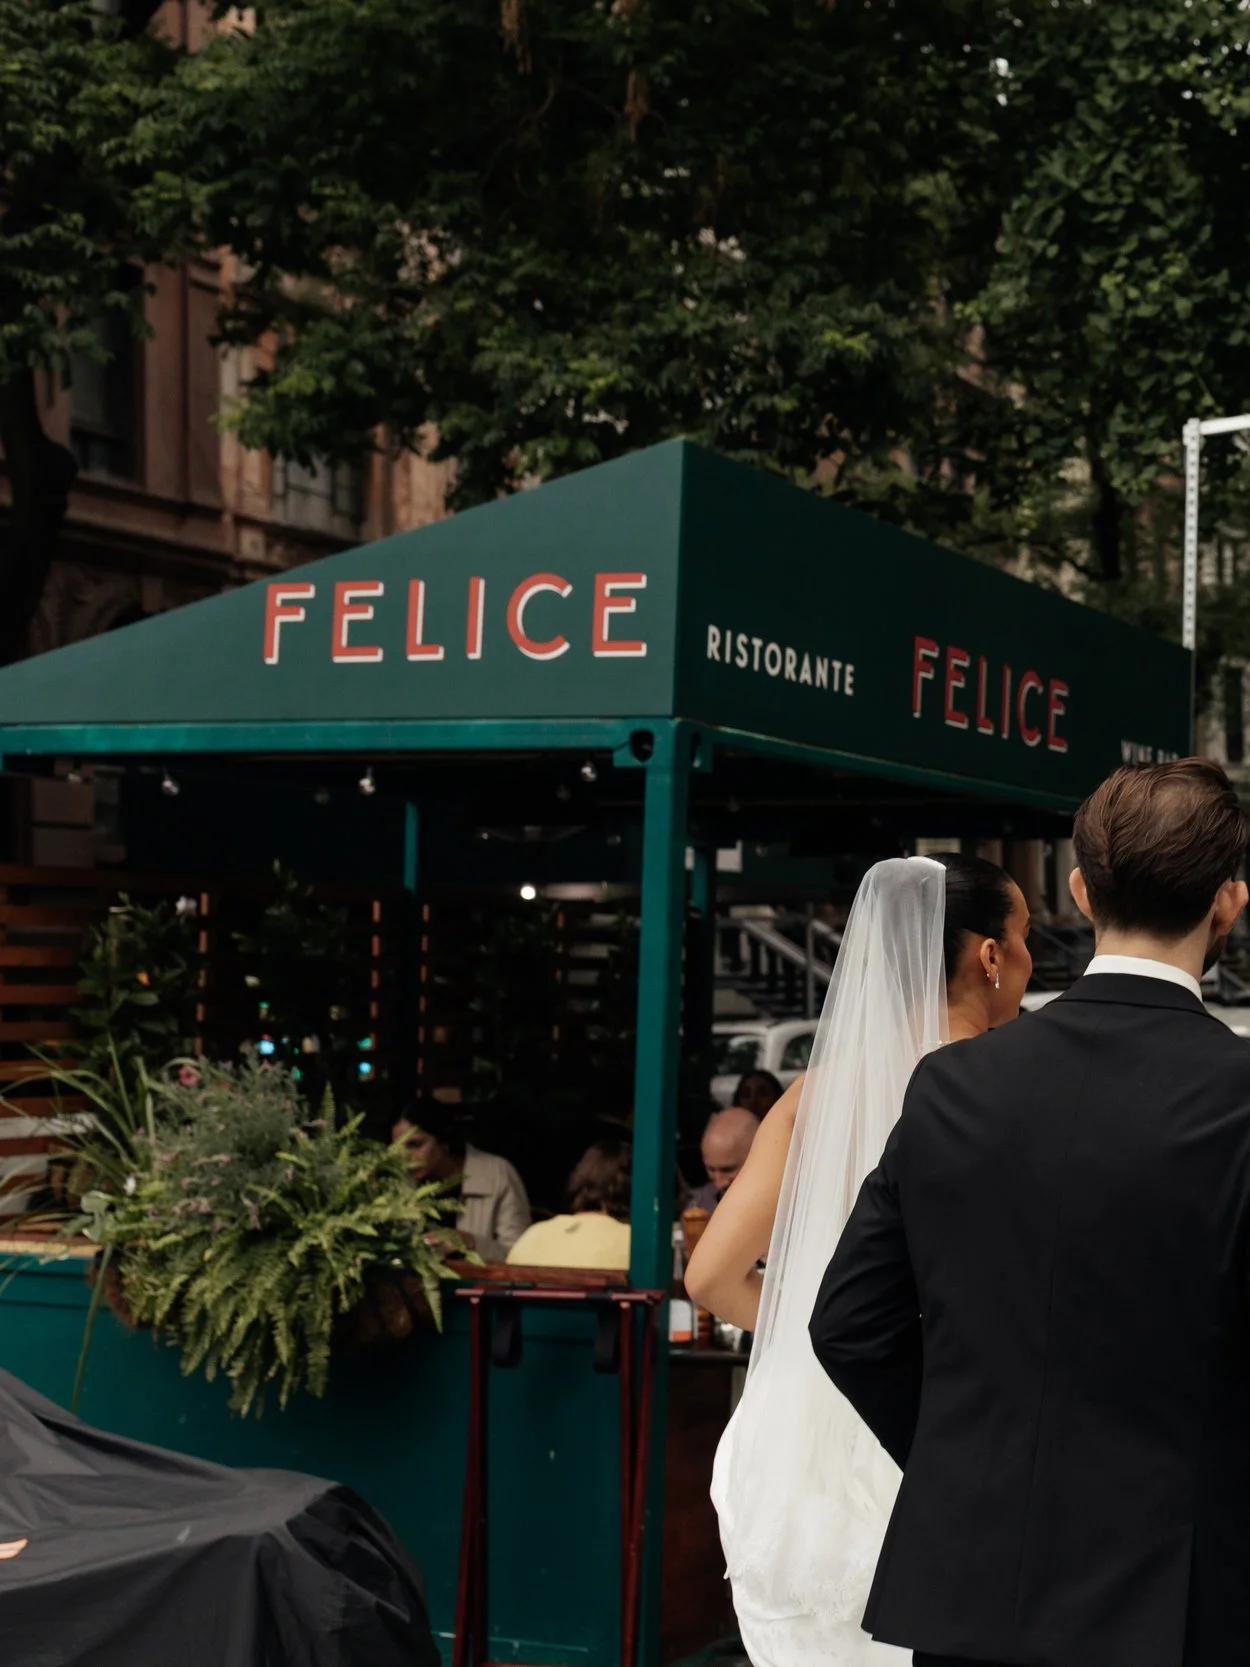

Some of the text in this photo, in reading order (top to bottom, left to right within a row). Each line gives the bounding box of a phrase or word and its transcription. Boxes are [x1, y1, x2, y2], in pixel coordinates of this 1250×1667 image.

[263, 572, 647, 665] FELICE
[706, 624, 854, 696] RISTORANTE
[912, 635, 1069, 753] FELICE
